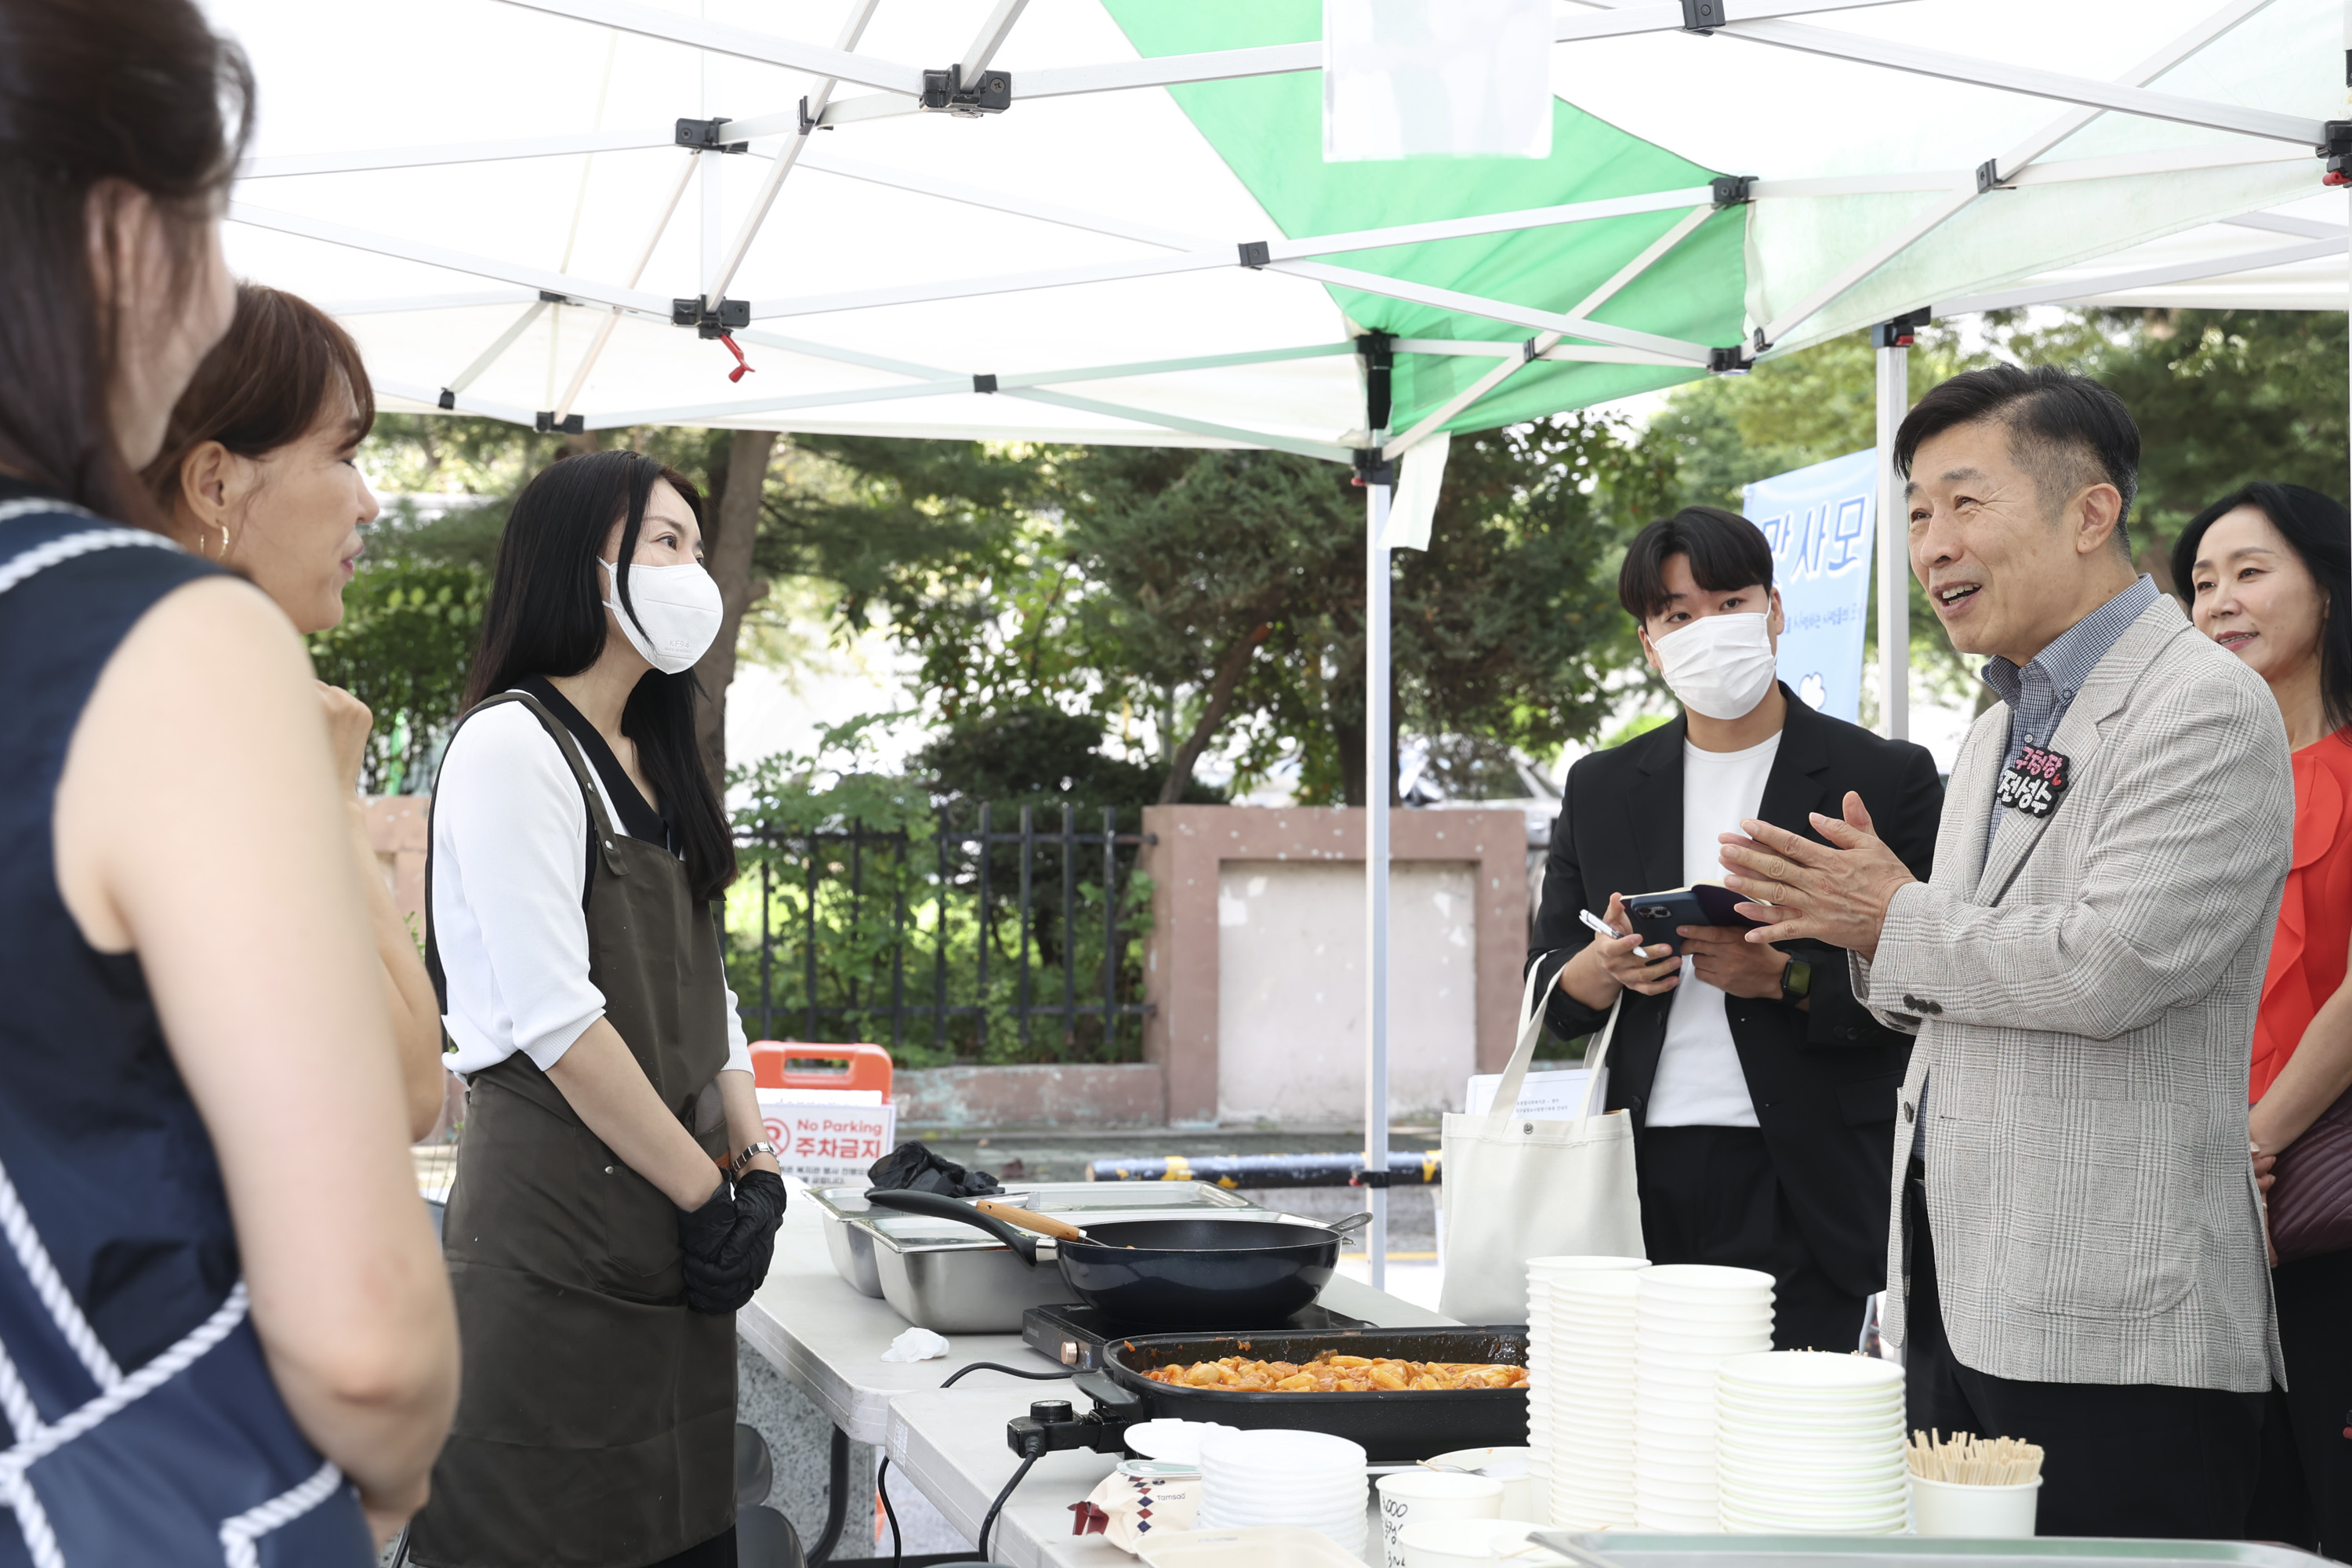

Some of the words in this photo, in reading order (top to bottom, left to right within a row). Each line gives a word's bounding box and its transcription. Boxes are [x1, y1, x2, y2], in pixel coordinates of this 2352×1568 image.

[670, 639, 690, 649] KF94
[2015, 746, 2063, 779] 구청장
[1996, 769, 2053, 814] 전성수
[797, 1119, 818, 1131] No
[823, 1118, 883, 1137] Parking
[795, 1137, 881, 1160] 주차금지
